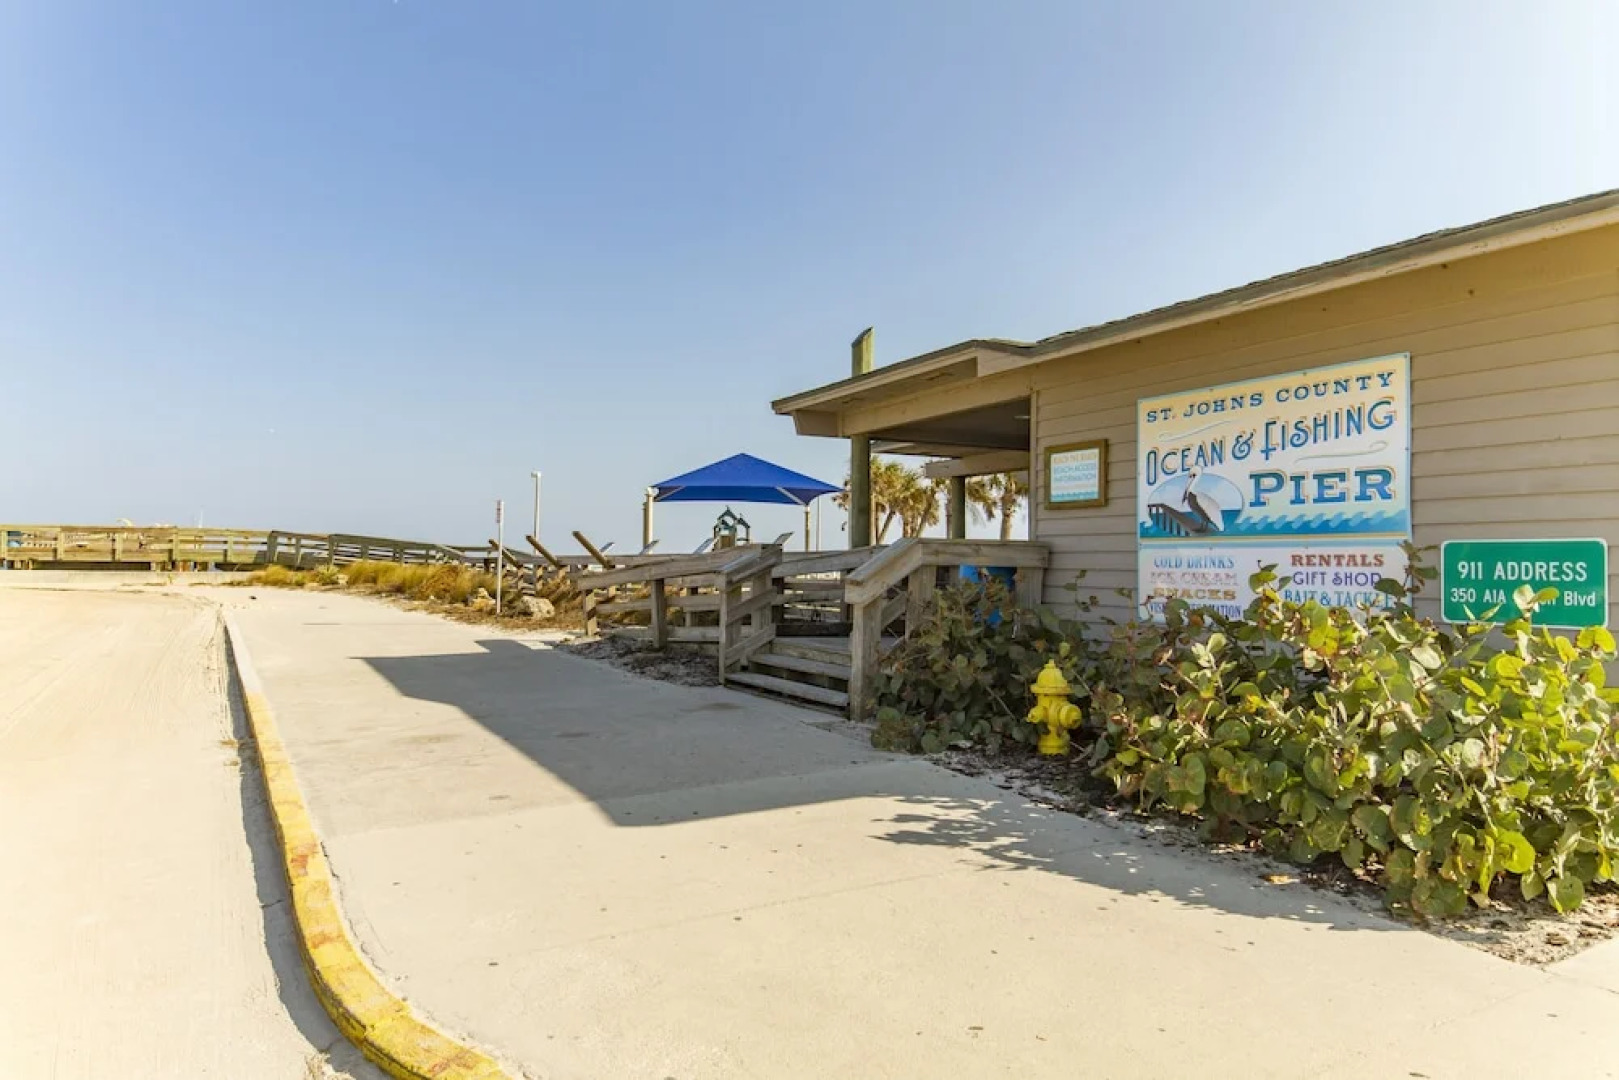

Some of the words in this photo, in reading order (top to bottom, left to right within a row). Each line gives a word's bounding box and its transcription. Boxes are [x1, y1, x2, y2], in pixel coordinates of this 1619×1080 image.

[1147, 408, 1175, 423] ST.
[1183, 393, 1263, 418] JOHNS
[1276, 371, 1395, 403] COUNTY
[1146, 438, 1225, 486] OCEAN
[1231, 432, 1254, 460] &
[1260, 399, 1396, 461] FISHING
[1249, 467, 1396, 508] PIER
[1153, 556, 1183, 569] COLD
[1187, 556, 1235, 569] DRINKS
[1290, 553, 1385, 568] RENTALS
[1150, 571, 1177, 584] ICE
[1181, 571, 1240, 586] CREAM
[1293, 571, 1327, 586] GIFT
[1332, 571, 1383, 587] SHOP
[1457, 560, 1484, 580] 911
[1493, 561, 1588, 582] ADDRESS
[1153, 587, 1237, 600] SNACKS
[1284, 589, 1318, 604] BAIT
[1320, 590, 1332, 607] &
[1450, 587, 1476, 603] 350
[1483, 588, 1507, 604] A1A
[1564, 590, 1597, 607] Blvd
